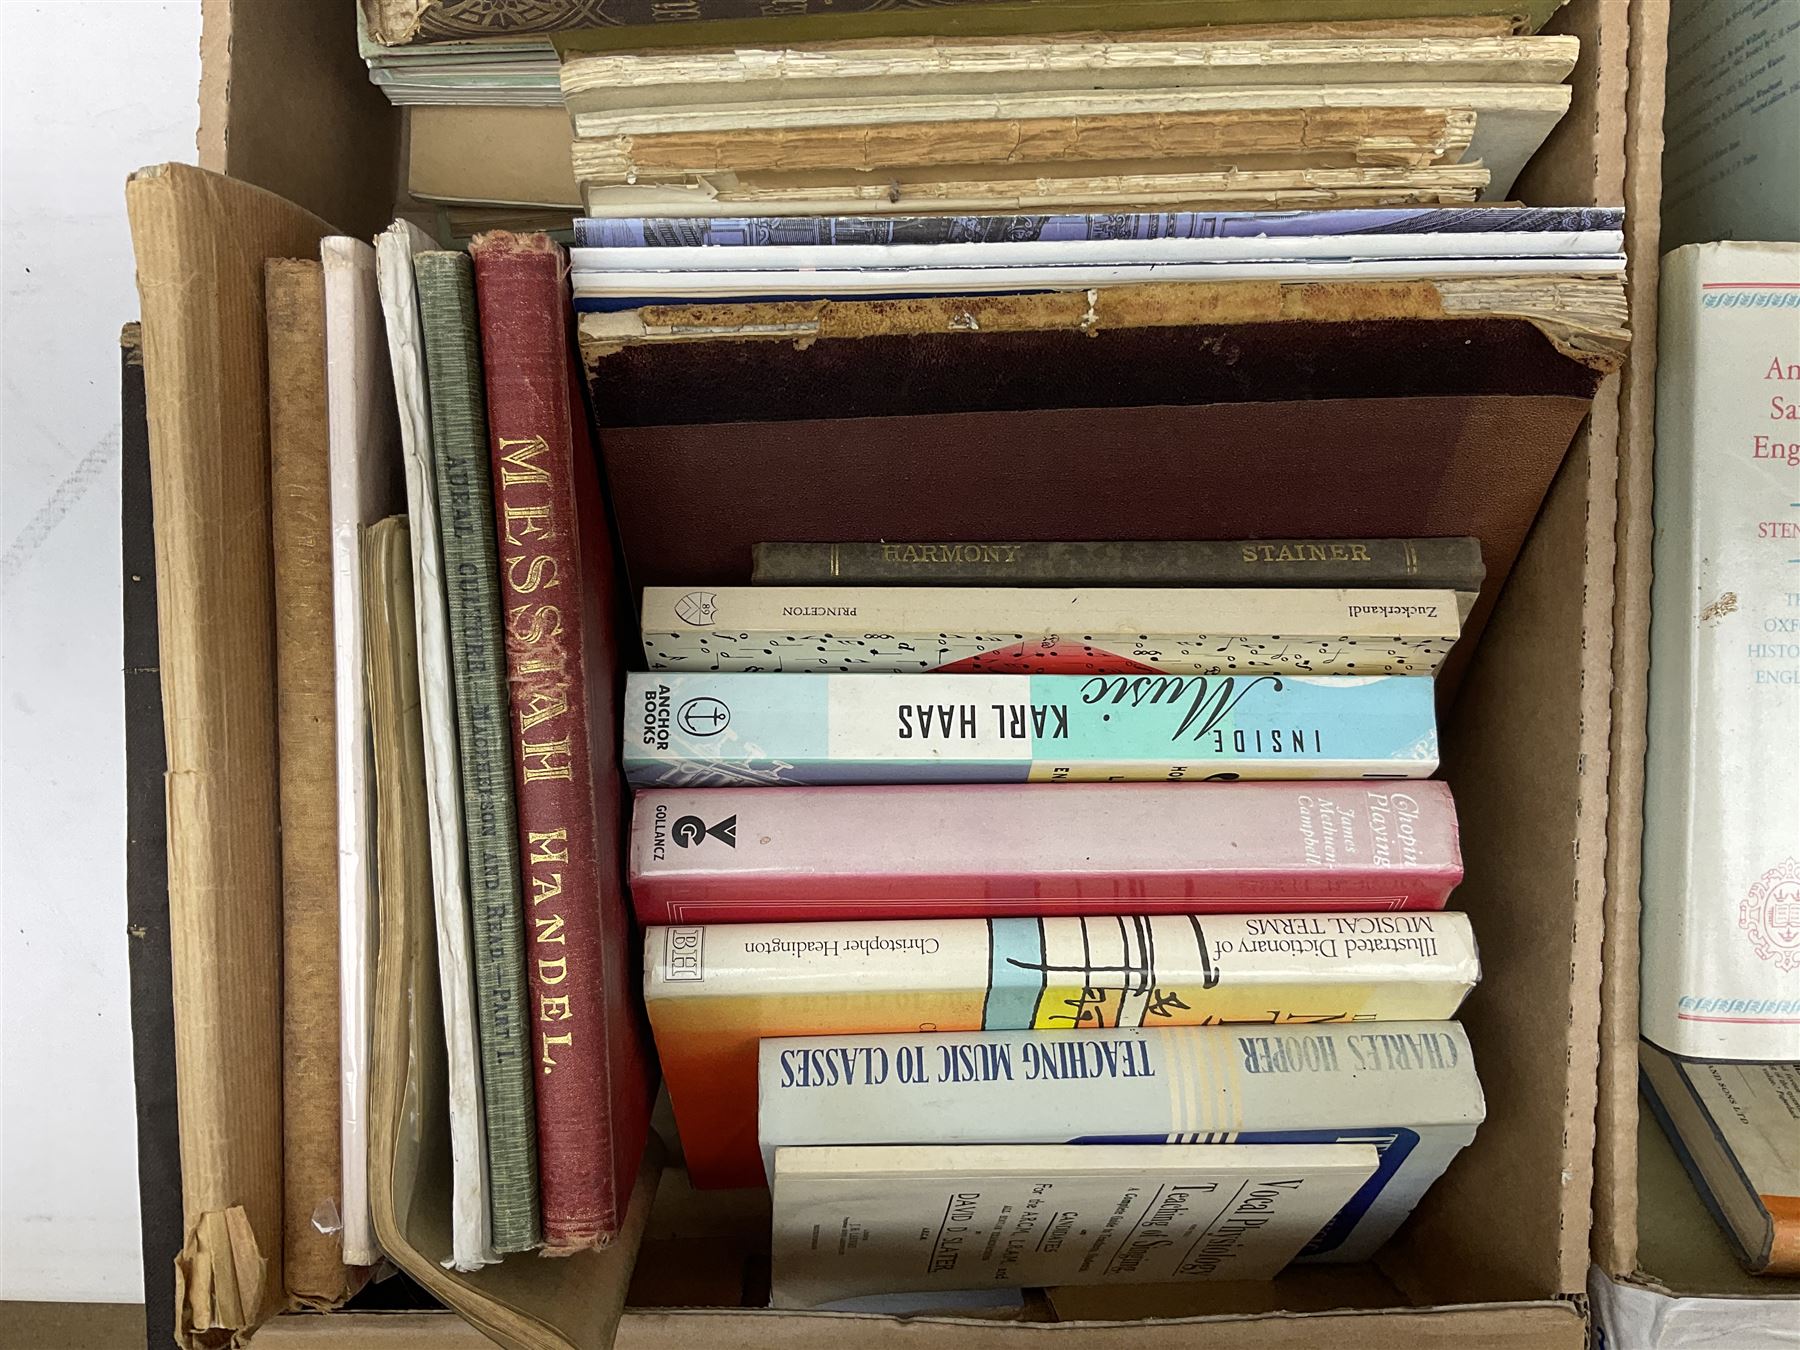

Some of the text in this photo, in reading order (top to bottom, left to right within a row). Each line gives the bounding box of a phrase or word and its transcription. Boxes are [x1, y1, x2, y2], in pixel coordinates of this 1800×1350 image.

[1764, 356, 1800, 380] An
[1753, 435, 1800, 467] Eng
[447, 456, 473, 538] AURAL
[882, 543, 1371, 565] HARMONY STAINER
[499, 434, 573, 785] MESSIAH
[782, 606, 858, 617] PRINCETON
[1347, 604, 1438, 619] Zuckerkandl
[643, 690, 657, 746] BOOKS
[656, 684, 671, 751] ANCHOR
[898, 704, 1069, 739] KARL HAAS
[1080, 675, 1283, 742] Music
[1213, 728, 1321, 753] INSIDE
[653, 804, 668, 862] GOLLANCZ
[1297, 794, 1320, 866] Campbell
[1337, 805, 1356, 854] James
[1366, 791, 1391, 869] Playing
[1391, 791, 1424, 868] Chopin
[1246, 916, 1435, 936] MUSICAL TERMS
[744, 935, 940, 958] Christopher Headington
[1213, 936, 1438, 962] Illustrated Dictionary of
[780, 1039, 1156, 1089] TEACHING MUSIC TO CLASSES
[1238, 1031, 1460, 1074] CHARLES HOOPER
[1719, 1081, 1737, 1105] SONS
[1023, 1198, 1046, 1208] the
[1028, 1182, 1053, 1195] For
[1108, 1192, 1139, 1215] Complete
[1139, 1181, 1220, 1227] Teaching
[947, 1192, 981, 1222] DAVID
[1040, 1210, 1081, 1253] CANDIDATES
[1137, 1228, 1173, 1238] of
[1174, 1177, 1306, 1277] Vocal Physiology
